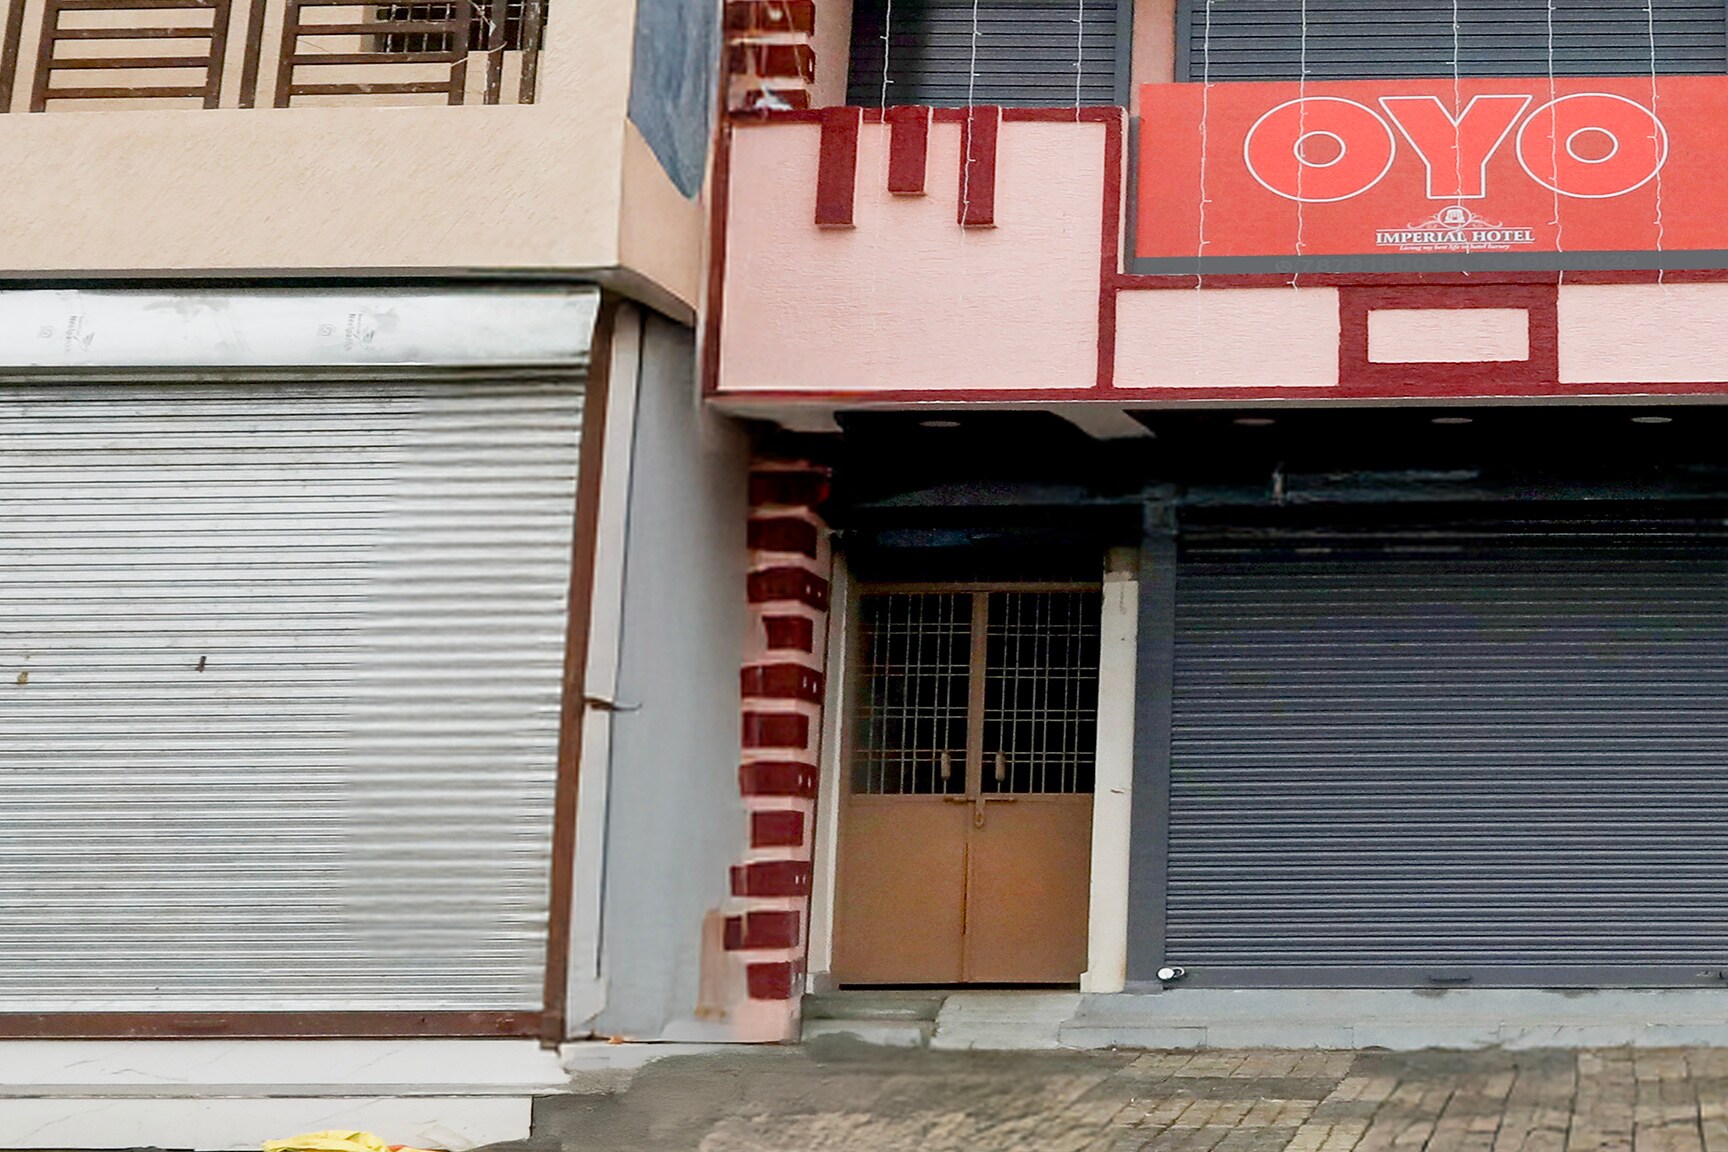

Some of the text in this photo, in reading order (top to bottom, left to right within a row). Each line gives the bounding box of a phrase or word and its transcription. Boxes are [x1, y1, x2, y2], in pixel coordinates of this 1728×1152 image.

[1243, 92, 1669, 203] OYO
[1375, 230, 1535, 243] IMPERIAL HOTEL
